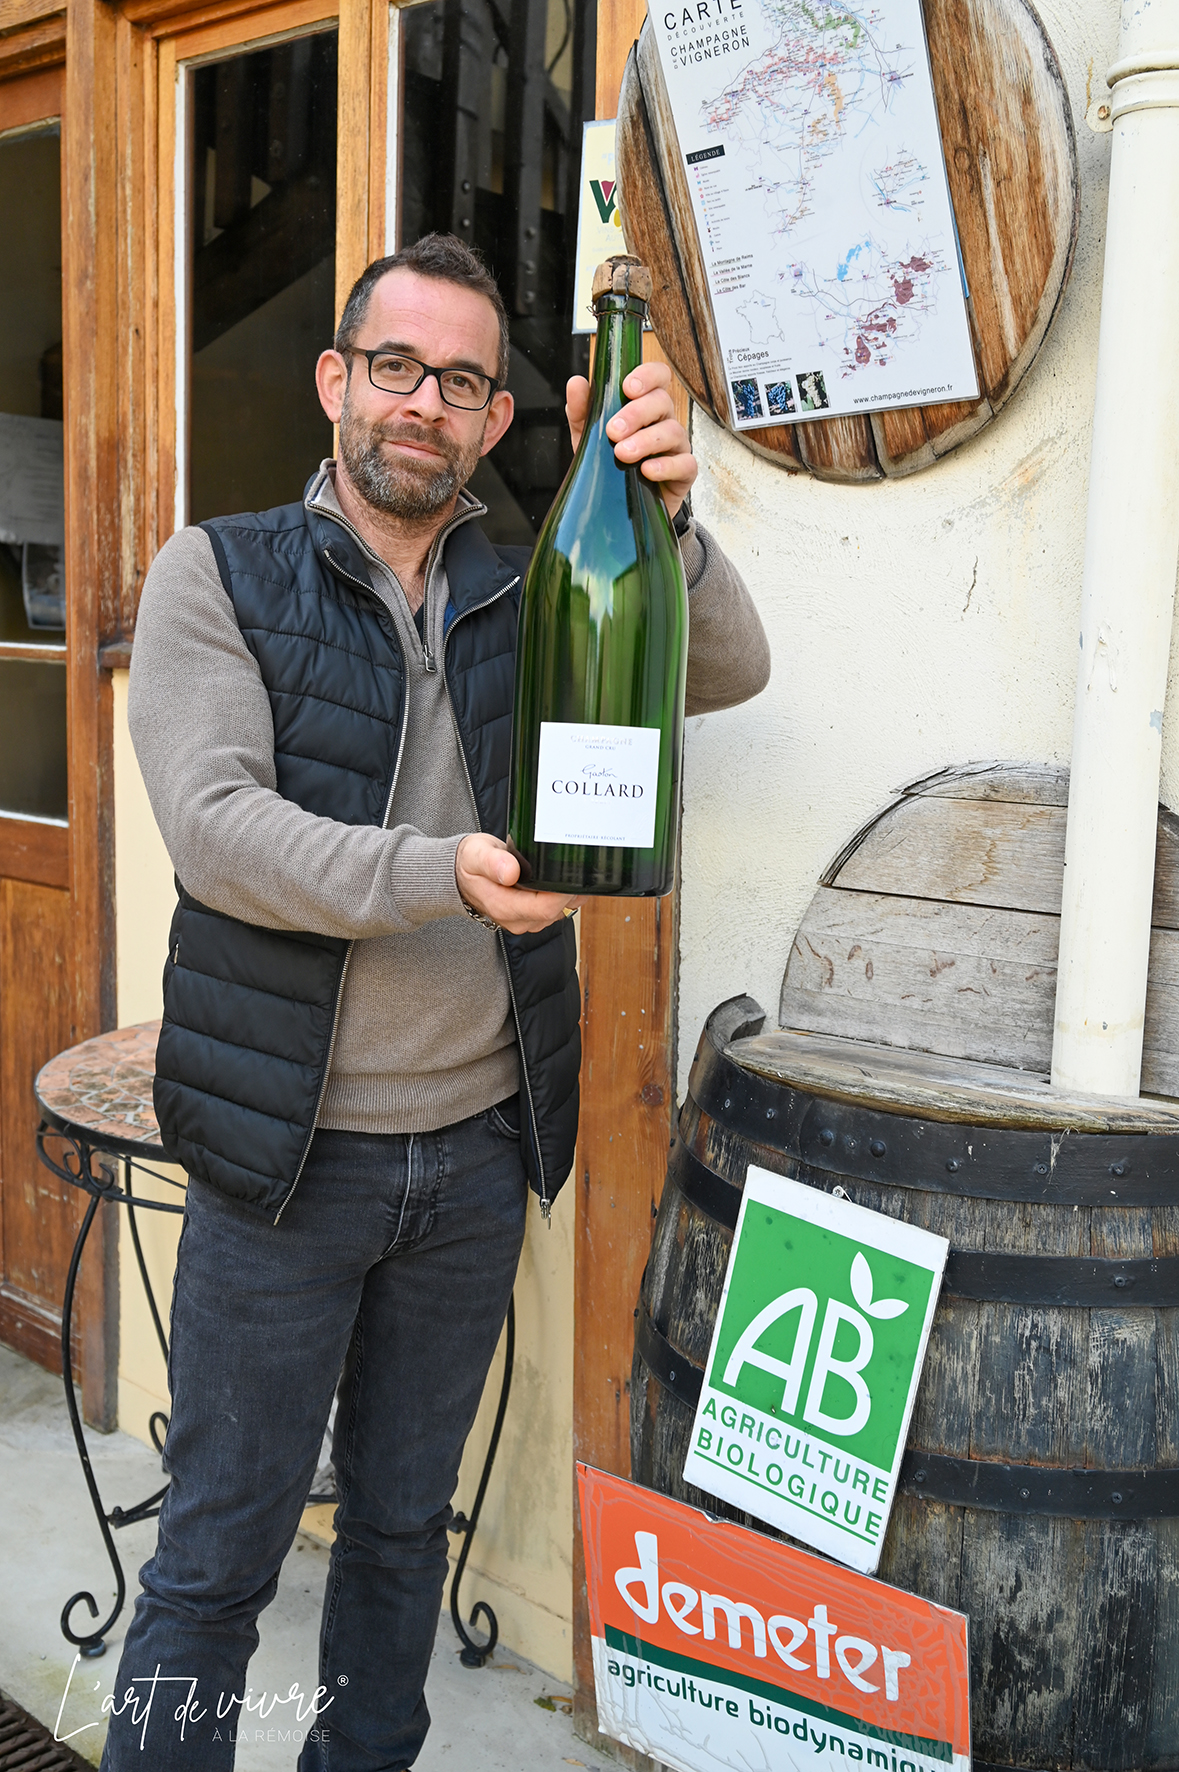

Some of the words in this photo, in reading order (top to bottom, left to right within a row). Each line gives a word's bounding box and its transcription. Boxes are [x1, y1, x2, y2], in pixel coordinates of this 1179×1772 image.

[664, 0, 742, 31] CARTE
[667, 11, 744, 41] DÉCOUVERTE
[670, 25, 747, 57] CHAMPAGNE
[680, 36, 750, 66] VIGNERON
[691, 149, 721, 162] LÉGENDE
[737, 351, 769, 362] Cépages
[853, 384, 953, 404] www.champagnedevigneron.fr
[551, 779, 644, 799] COLLARD
[722, 1287, 874, 1437] AB
[702, 1397, 890, 1505] AGRICULTURE
[696, 1426, 884, 1538] BIOLOGIQUE
[613, 1530, 911, 1702] demeter
[608, 1656, 739, 1720] agriculture
